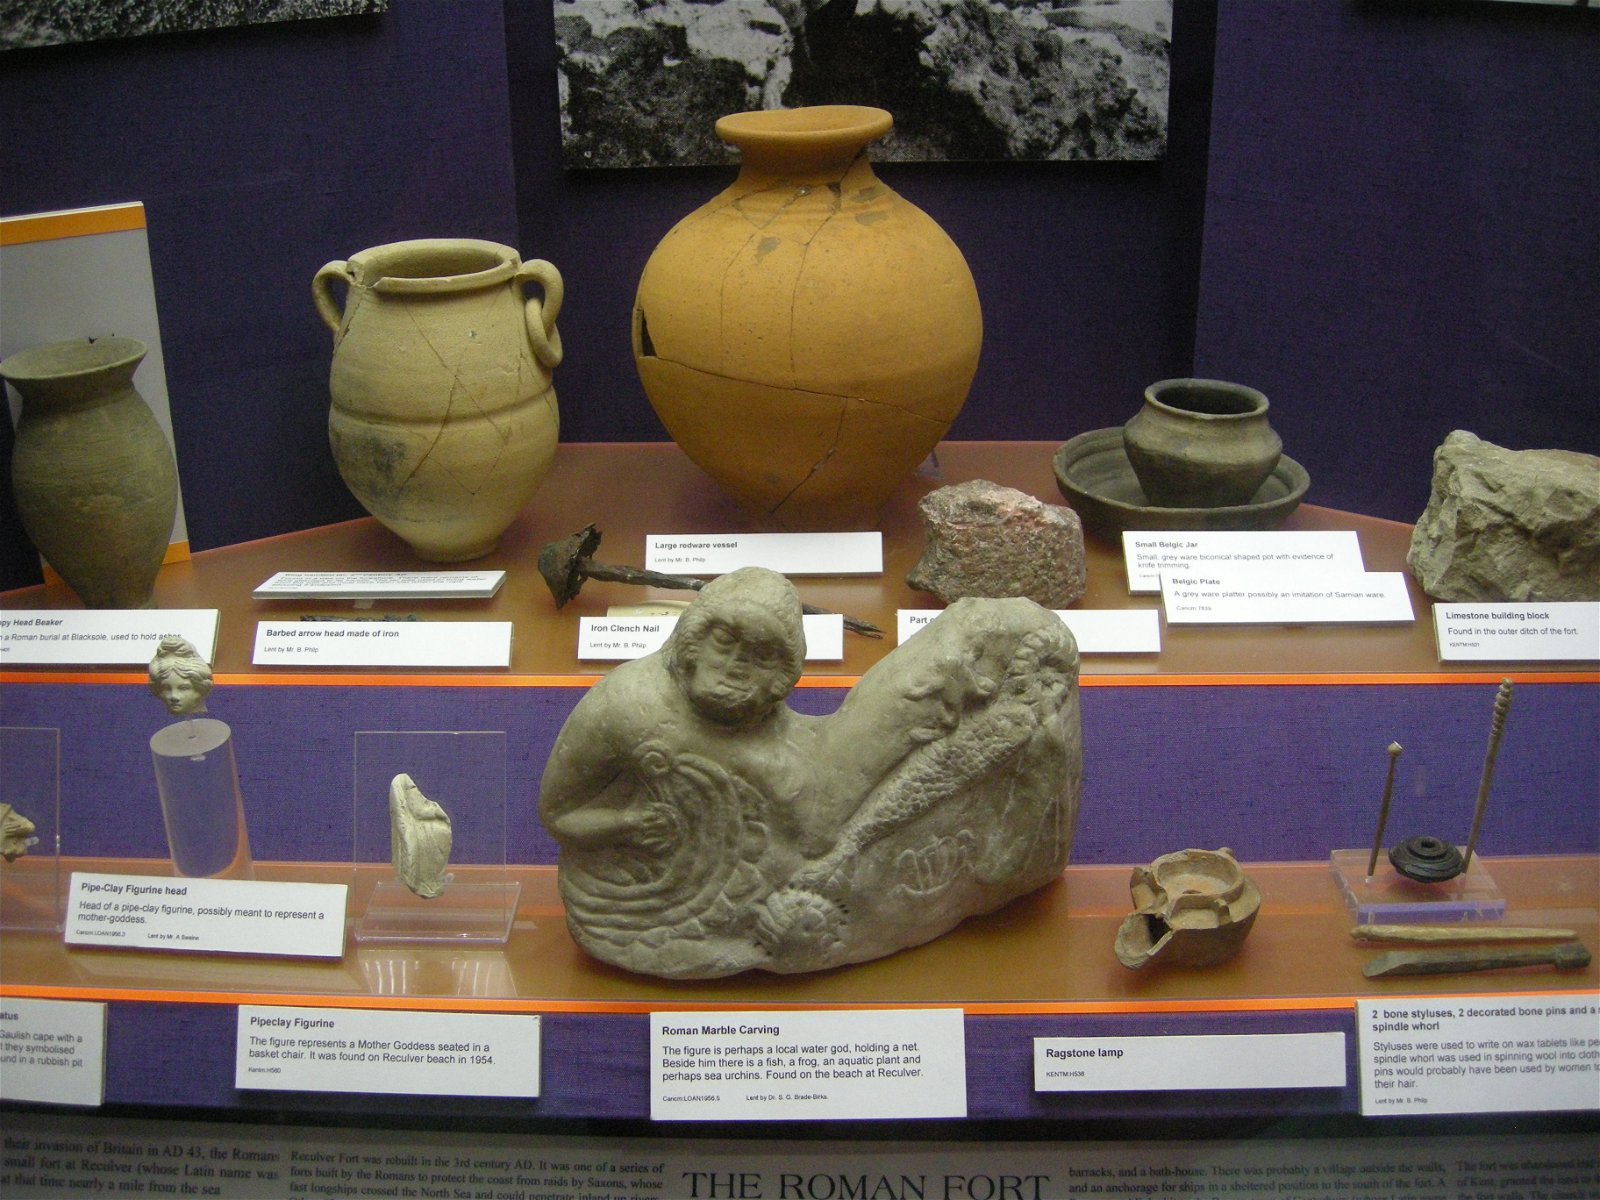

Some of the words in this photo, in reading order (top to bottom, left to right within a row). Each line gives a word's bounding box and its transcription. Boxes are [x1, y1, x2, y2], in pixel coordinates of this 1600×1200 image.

[1491, 612, 1525, 620] building
[81, 883, 123, 894] Pipe-Clay
[126, 885, 162, 896] Figurine
[165, 887, 187, 895] head
[80, 901, 102, 910] Head
[104, 902, 112, 910] of
[122, 904, 159, 914] pipe-clay
[198, 907, 232, 917] possibly
[235, 909, 262, 917] meant
[275, 911, 316, 920] represent
[1372, 1010, 1378, 1018] 2
[1384, 1010, 1408, 1018] bone
[1459, 1008, 1464, 1017] 2
[1467, 1008, 1516, 1017] decorated
[1519, 1007, 1543, 1016] bone
[1546, 1007, 1566, 1016] pins
[1570, 1006, 1587, 1014] and
[250, 1017, 291, 1028] Pipeclay
[294, 1018, 334, 1030] Figurine
[1372, 1022, 1409, 1032] spindle
[1412, 1022, 1439, 1030] whorl
[662, 1026, 698, 1035] Roman
[702, 1026, 736, 1034] Marble
[739, 1025, 779, 1035] Carving
[33, 1034, 54, 1042] cape
[57, 1034, 74, 1042] with
[250, 1036, 267, 1045] The
[270, 1037, 295, 1048] figure
[298, 1040, 346, 1048] represents
[358, 1040, 390, 1049] Mother
[394, 1041, 435, 1050] Goddess
[438, 1043, 470, 1052] seated
[473, 1043, 480, 1051] in
[4, 1043, 24, 1053] they
[25, 1045, 75, 1055] symbolised
[662, 1046, 681, 1055] The
[684, 1046, 711, 1055] figure
[714, 1046, 721, 1054] is
[725, 1046, 764, 1055] perhaps
[776, 1045, 798, 1054] local
[801, 1045, 828, 1053] water
[855, 1043, 890, 1054] holding
[893, 1044, 898, 1052] a
[1046, 1049, 1095, 1059] Ragstone
[1098, 1048, 1123, 1058] lamp
[249, 1049, 279, 1058] basket
[310, 1051, 315, 1059] It
[339, 1052, 365, 1061] found
[368, 1054, 379, 1062] on
[383, 1053, 424, 1063] Reculver
[427, 1054, 455, 1064] beach
[458, 1055, 466, 1064] in
[663, 1059, 695, 1068] Beside
[698, 1059, 716, 1067] him
[718, 1059, 743, 1067] there
[746, 1058, 754, 1066] is
[838, 1057, 873, 1066] aquatic
[876, 1056, 900, 1066] plant
[903, 1055, 920, 1064] and
[663, 1072, 702, 1082] perhaps
[766, 1070, 796, 1079] Found
[815, 1070, 830, 1078] the
[833, 1069, 862, 1078] beach
[1374, 1080, 1395, 1088] their
[291, 1151, 336, 1163] Reculver
[339, 1153, 359, 1163] Fort
[362, 1156, 382, 1164] was
[386, 1155, 418, 1166] rebuilt
[421, 1156, 431, 1166] in
[435, 1156, 450, 1167] the
[453, 1157, 470, 1168] 3rd
[474, 1160, 511, 1170] century
[537, 1160, 547, 1170] It
[549, 1163, 571, 1171] was
[596, 1162, 608, 1172] of
[619, 1162, 649, 1173] series
[652, 1163, 664, 1173] of
[682, 1172, 762, 1198] THE
[780, 1174, 927, 1200] ROMAN
[944, 1175, 1050, 1200] FORT
